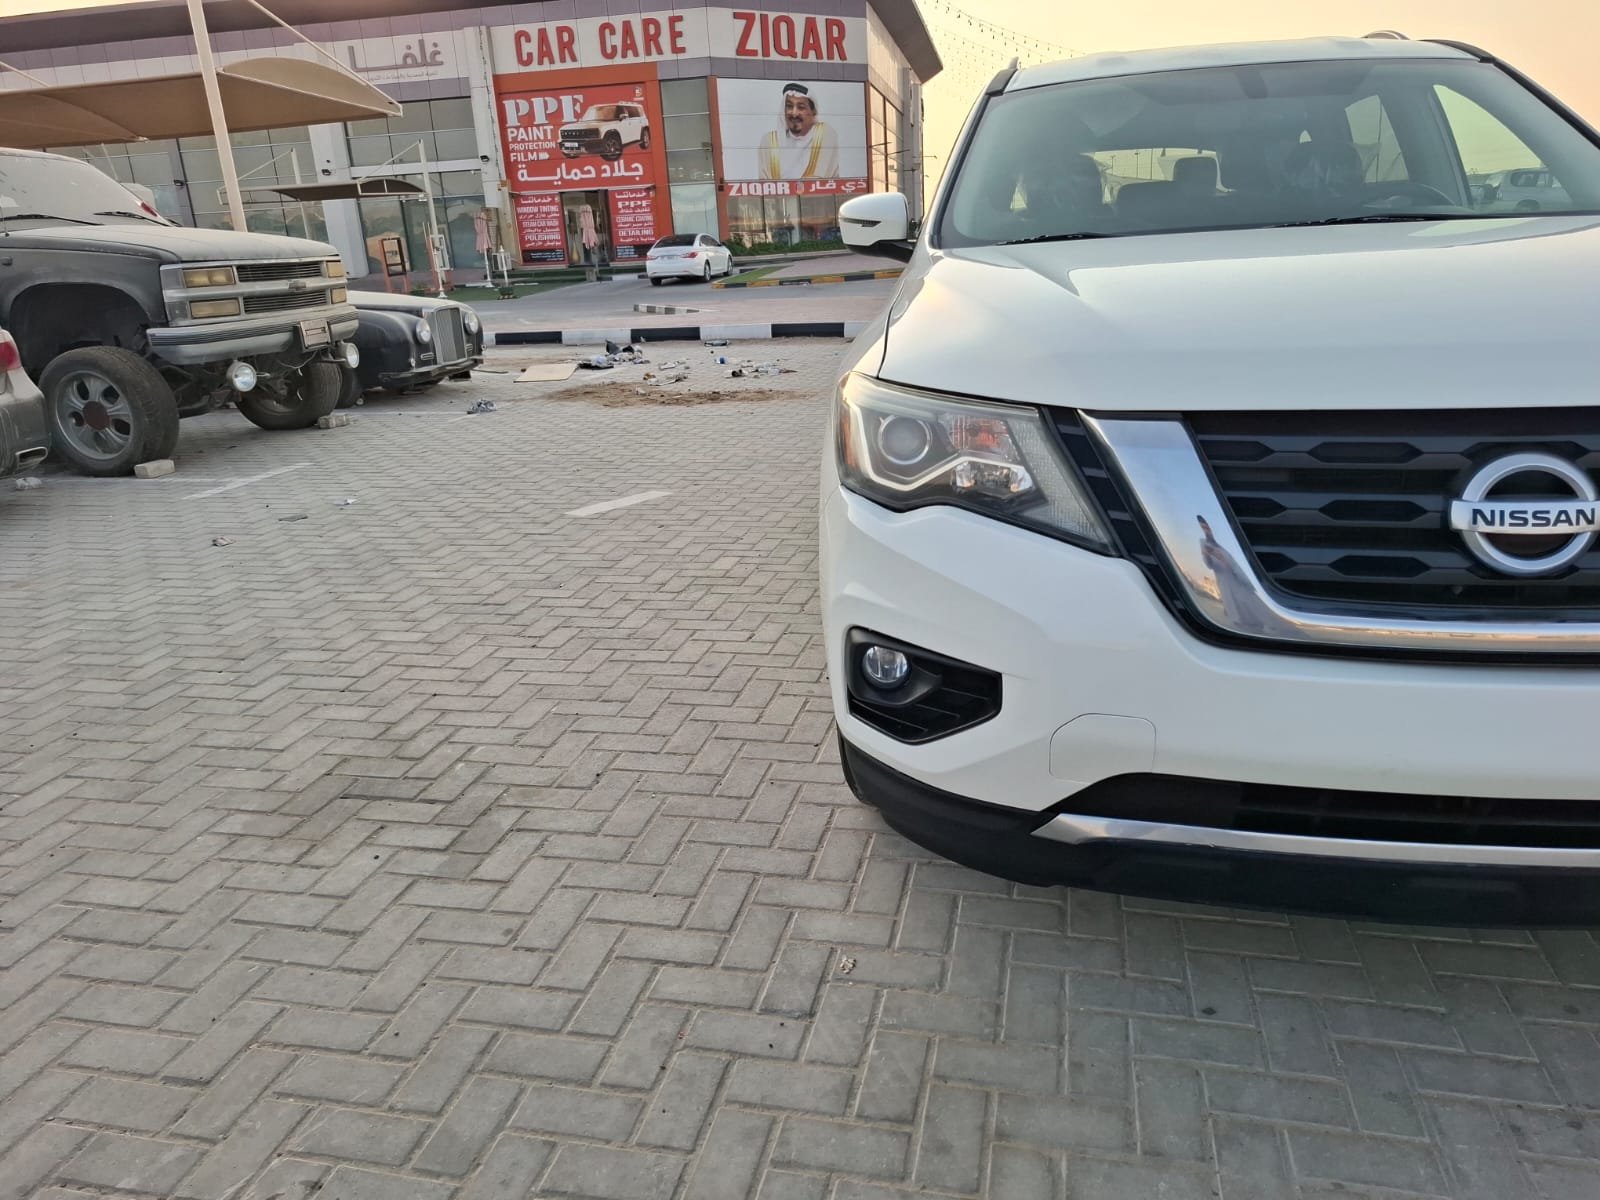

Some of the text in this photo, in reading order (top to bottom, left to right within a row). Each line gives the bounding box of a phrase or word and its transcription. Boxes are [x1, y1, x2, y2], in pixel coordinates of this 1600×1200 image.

[514, 15, 687, 67] CAR CARE
[733, 11, 848, 61] ZIQAR
[502, 94, 584, 127] PPF
[507, 125, 554, 142] PAINT
[509, 141, 556, 151] PROTECTION
[510, 151, 538, 162] FILM
[517, 159, 644, 185] جلاد حماية
[727, 181, 790, 196] ZIQAR
[809, 179, 867, 193] ذي قار
[617, 199, 652, 209] PPF
[1471, 507, 1596, 528] NISSAN
